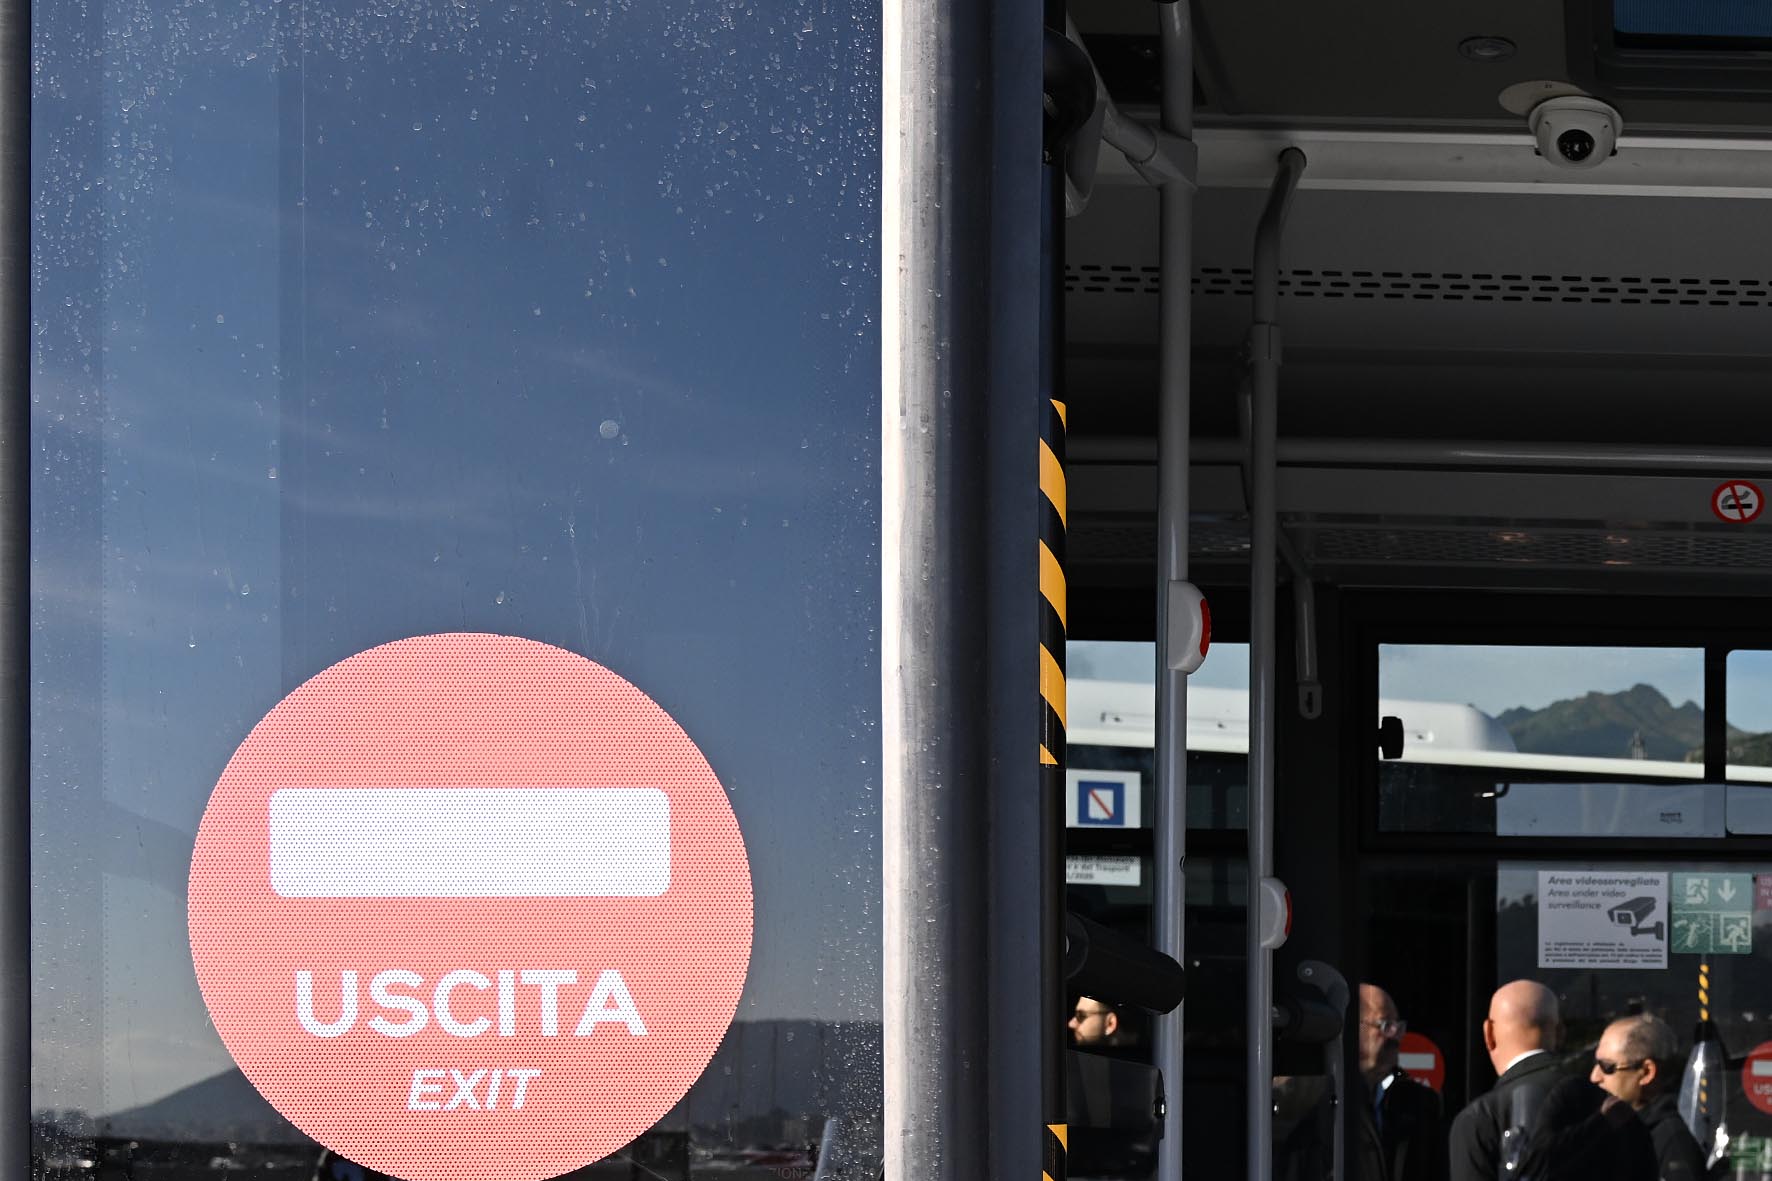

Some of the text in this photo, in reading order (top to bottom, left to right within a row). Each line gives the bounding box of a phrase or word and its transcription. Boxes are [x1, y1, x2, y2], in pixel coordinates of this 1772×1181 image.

[1548, 877, 1572, 885] Area
[1548, 889, 1626, 898] Area under video
[1548, 901, 1601, 909] surveillance
[294, 969, 648, 1038] USCITA
[405, 1069, 541, 1111] EXIT
